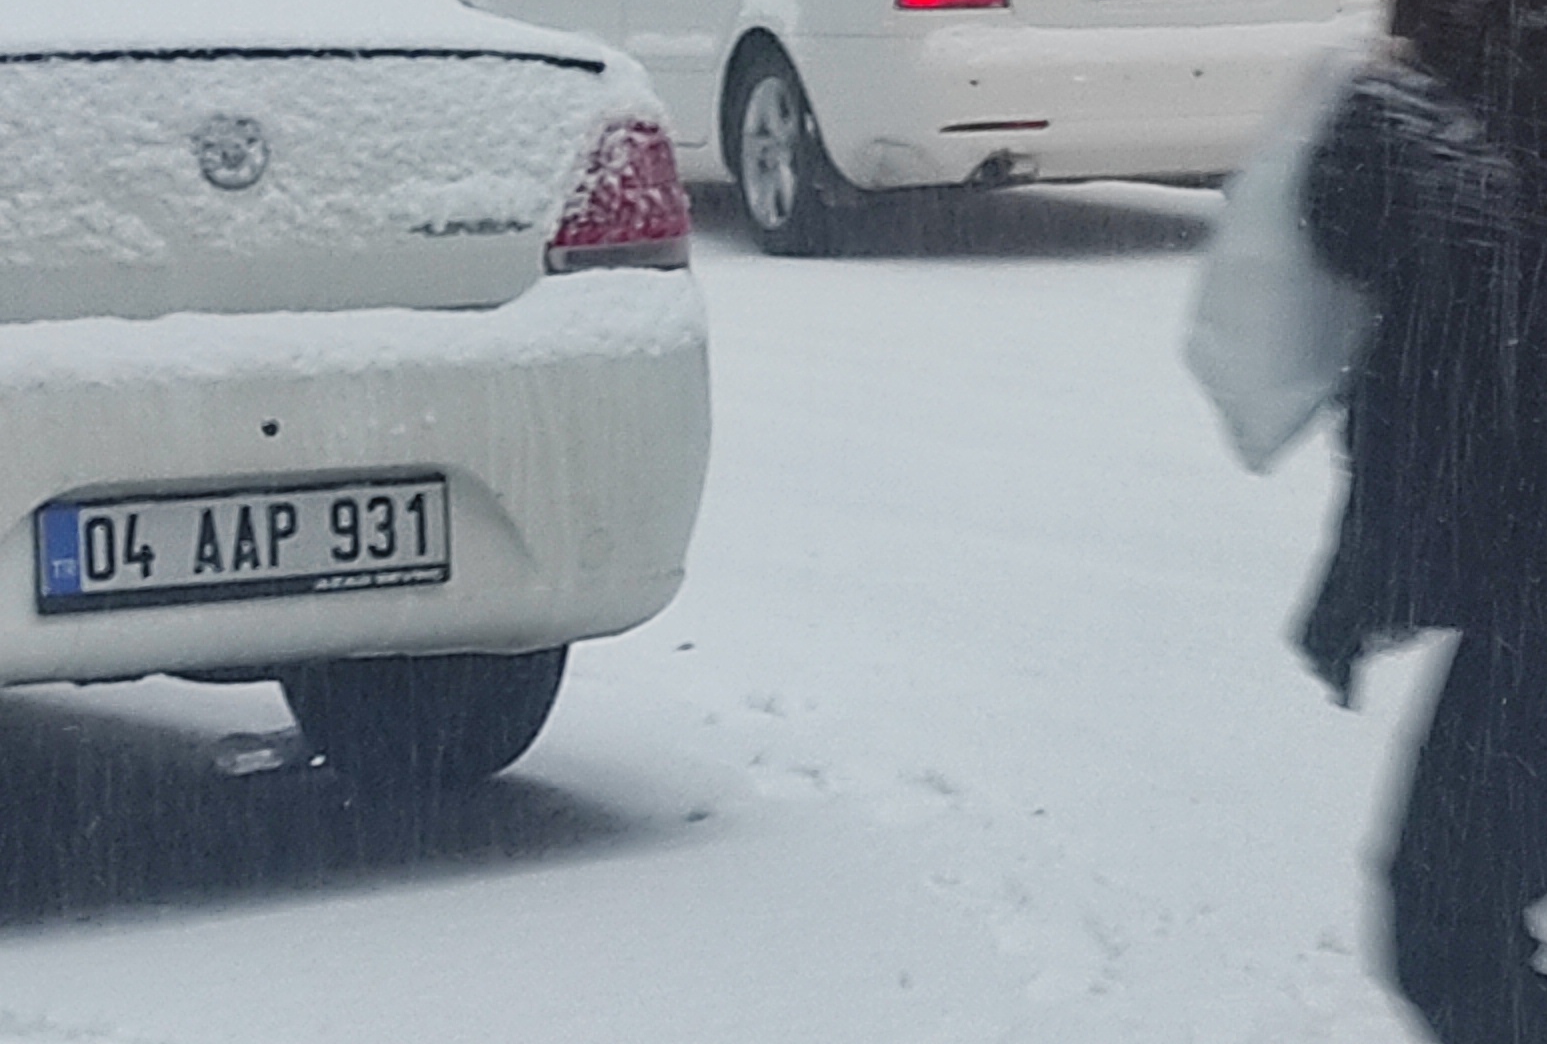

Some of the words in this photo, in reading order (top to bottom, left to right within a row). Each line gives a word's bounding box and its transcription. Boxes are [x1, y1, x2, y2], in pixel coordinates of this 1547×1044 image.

[84, 512, 156, 582] 04
[193, 501, 299, 576] AAP
[330, 491, 427, 562] 931
